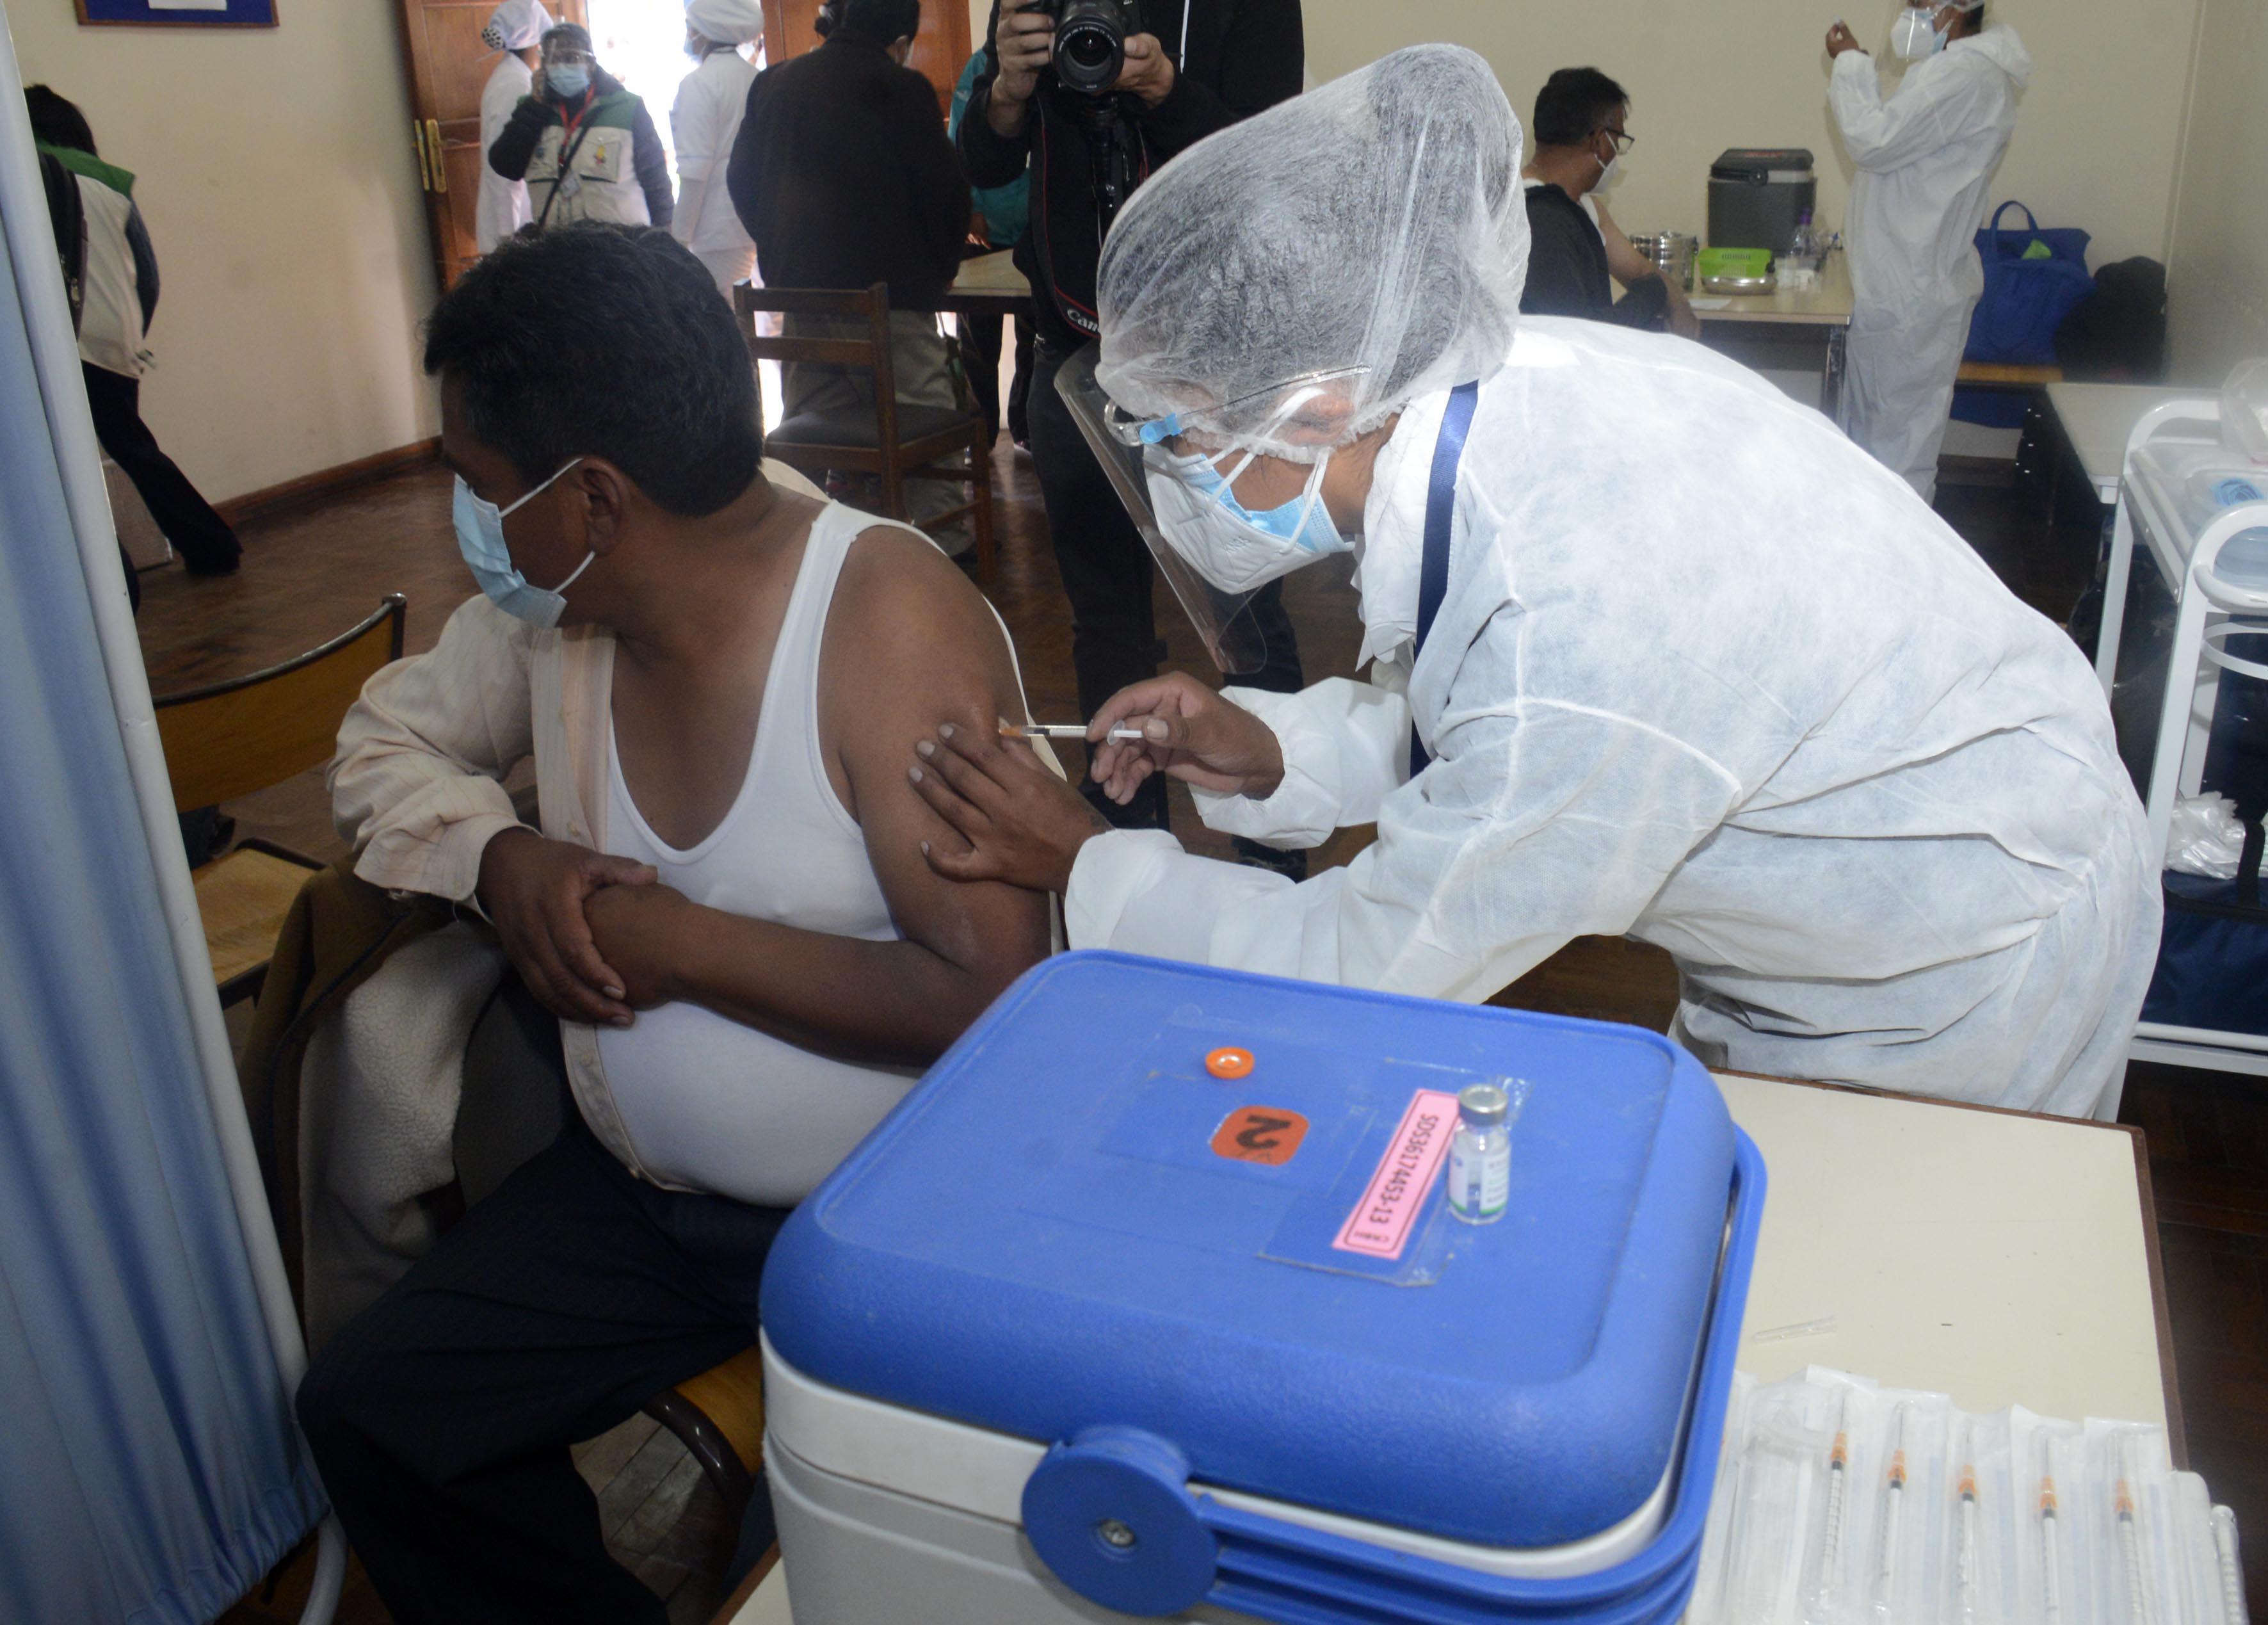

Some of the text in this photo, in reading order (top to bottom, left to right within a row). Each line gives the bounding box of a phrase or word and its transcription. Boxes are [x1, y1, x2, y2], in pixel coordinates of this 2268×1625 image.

[1067, 309, 1101, 333] Can
[1235, 1115, 1292, 1150] 2
[1369, 1113, 1439, 1224] SDS36174453-13
